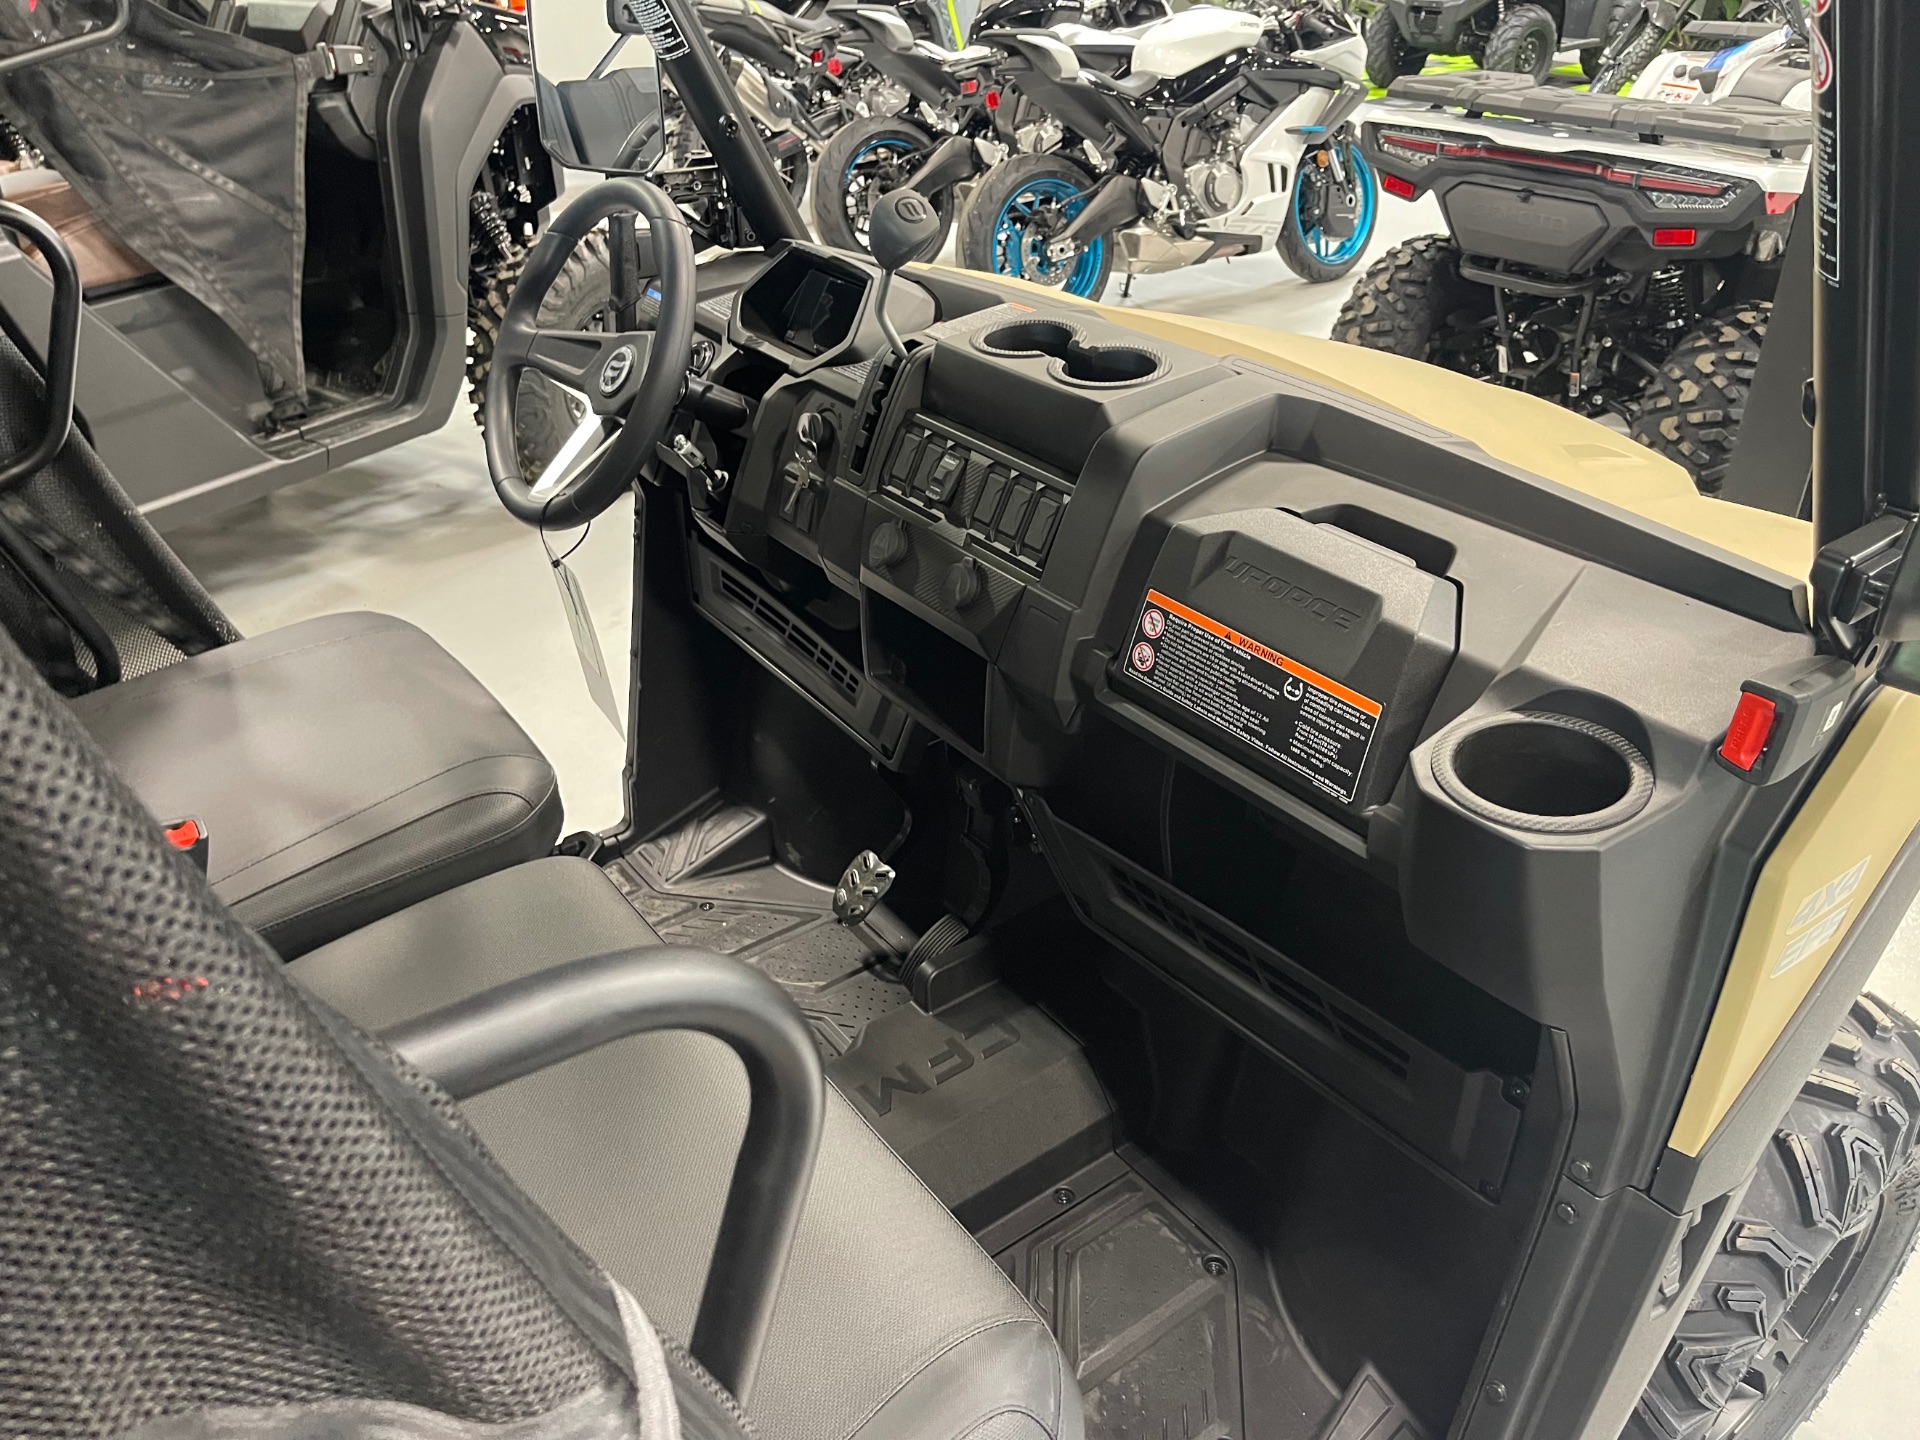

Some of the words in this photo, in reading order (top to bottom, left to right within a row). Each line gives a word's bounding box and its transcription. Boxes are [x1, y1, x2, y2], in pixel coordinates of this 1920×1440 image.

[1225, 555, 1362, 633] UFORCE
[1239, 636, 1284, 667] WARNING
[1299, 710, 1315, 721] severe
[1315, 718, 1329, 729] injury
[1301, 703, 1312, 713] Loss
[1318, 712, 1335, 725] control
[1335, 722, 1344, 730] can
[1345, 726, 1359, 737] result
[1305, 692, 1333, 711] overloading
[1333, 707, 1342, 715] can
[1343, 712, 1358, 724] cause
[1329, 697, 1337, 705] tire
[1337, 702, 1359, 717] pressure
[1298, 721, 1309, 731] Cold
[1310, 728, 1318, 736] tire
[1292, 739, 1315, 756] Maximum
[1314, 752, 1330, 765] weight
[1787, 857, 1869, 933] 4X4
[1771, 902, 1851, 978] EPS
[855, 1017, 1021, 1118] CFM
